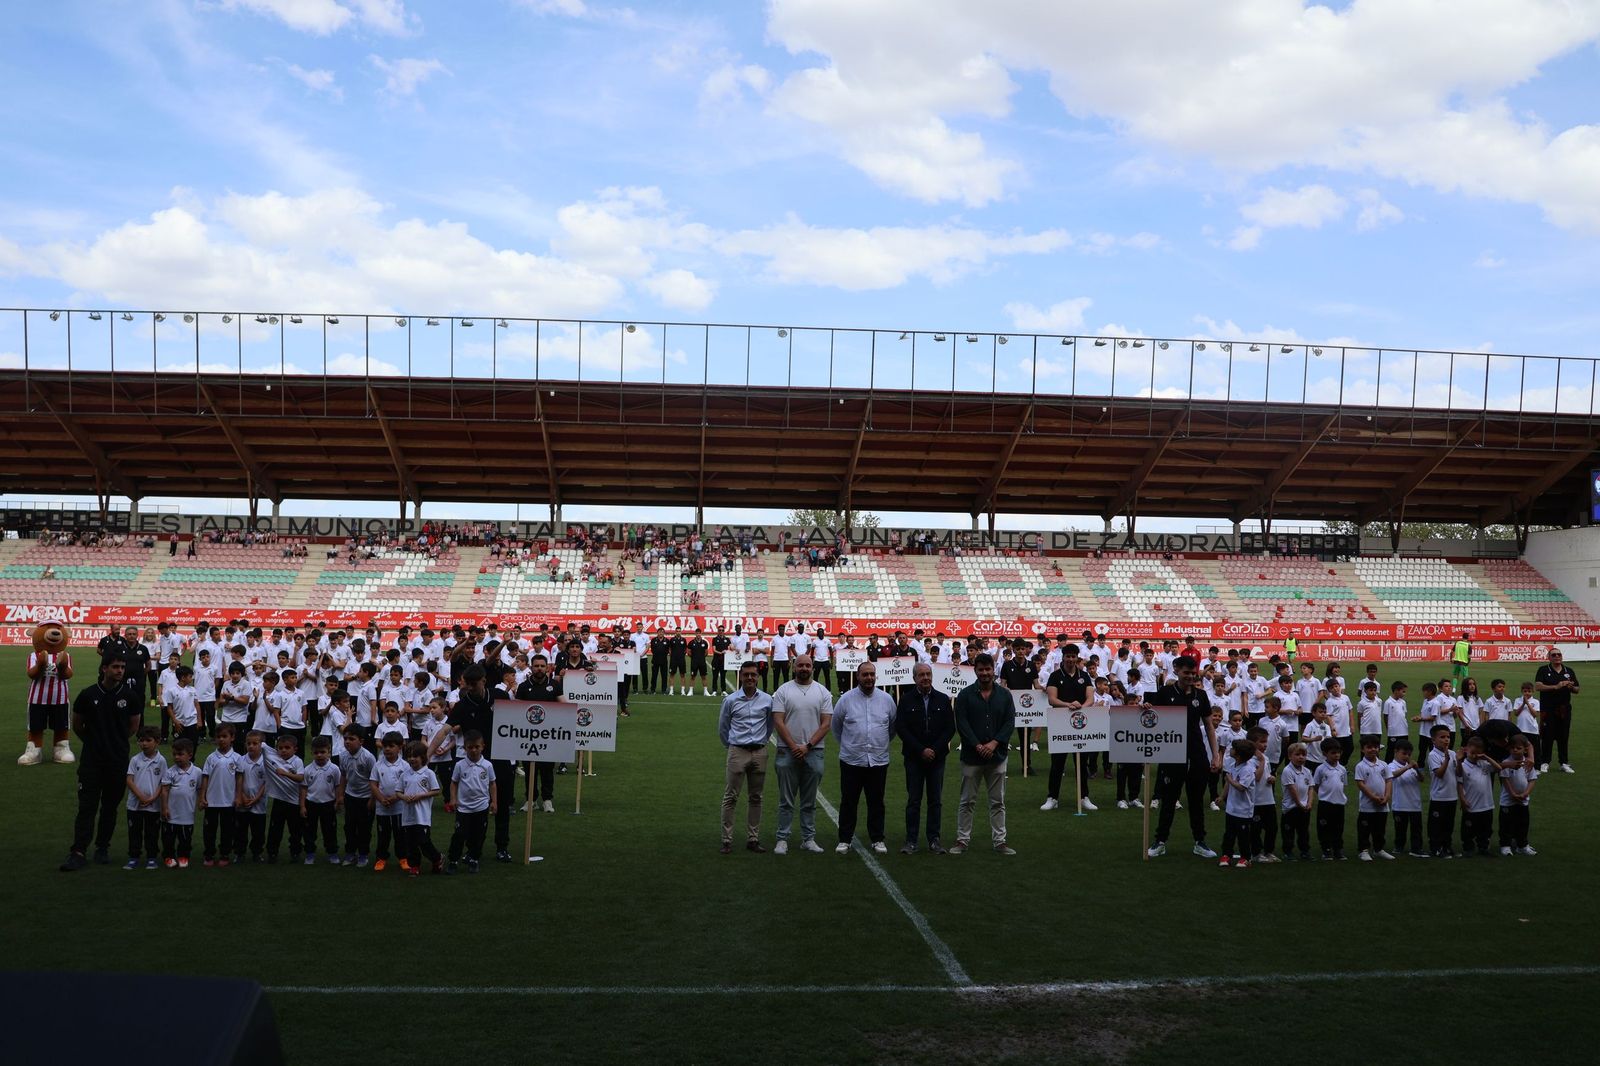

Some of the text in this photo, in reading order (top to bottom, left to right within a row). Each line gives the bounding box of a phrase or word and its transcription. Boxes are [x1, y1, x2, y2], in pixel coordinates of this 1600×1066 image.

[1051, 532, 1091, 549] DE
[1100, 532, 1231, 551] ZAMORA
[68, 606, 91, 622] CF
[654, 617, 769, 633] CAJA RURAL
[866, 620, 936, 629] recoletas salud
[1408, 625, 1447, 636] ZAMORA
[1345, 628, 1390, 636] leomotor.net
[1332, 645, 1366, 660] Opinión
[1394, 646, 1427, 660] Opinión
[884, 668, 910, 676] Infantil
[568, 692, 613, 701] Benjamín
[497, 725, 572, 741] Chupetín
[1052, 732, 1107, 741] PREBENJAMÍN
[1114, 730, 1183, 745] Chupetín
[520, 743, 548, 756] “A”
[1136, 746, 1161, 757] “B”
